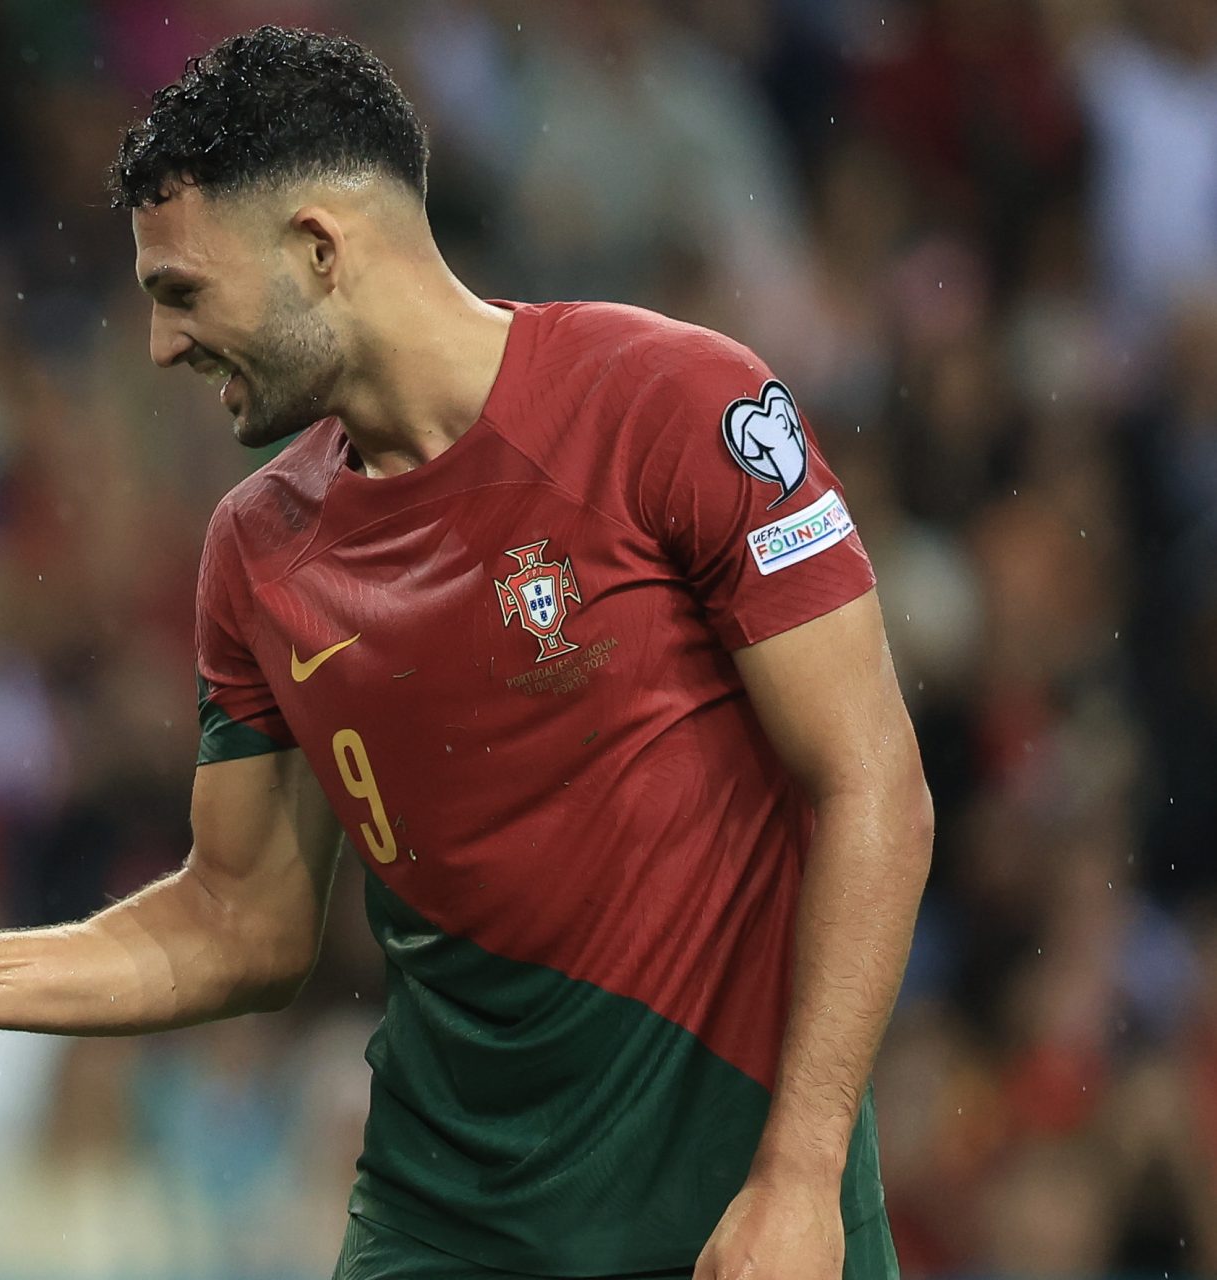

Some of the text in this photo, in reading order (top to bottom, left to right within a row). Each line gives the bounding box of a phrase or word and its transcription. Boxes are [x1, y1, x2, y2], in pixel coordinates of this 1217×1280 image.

[753, 525, 782, 545] UEFA
[582, 653, 611, 673] 2023
[552, 674, 590, 697] PORTO
[332, 728, 398, 864] 9
